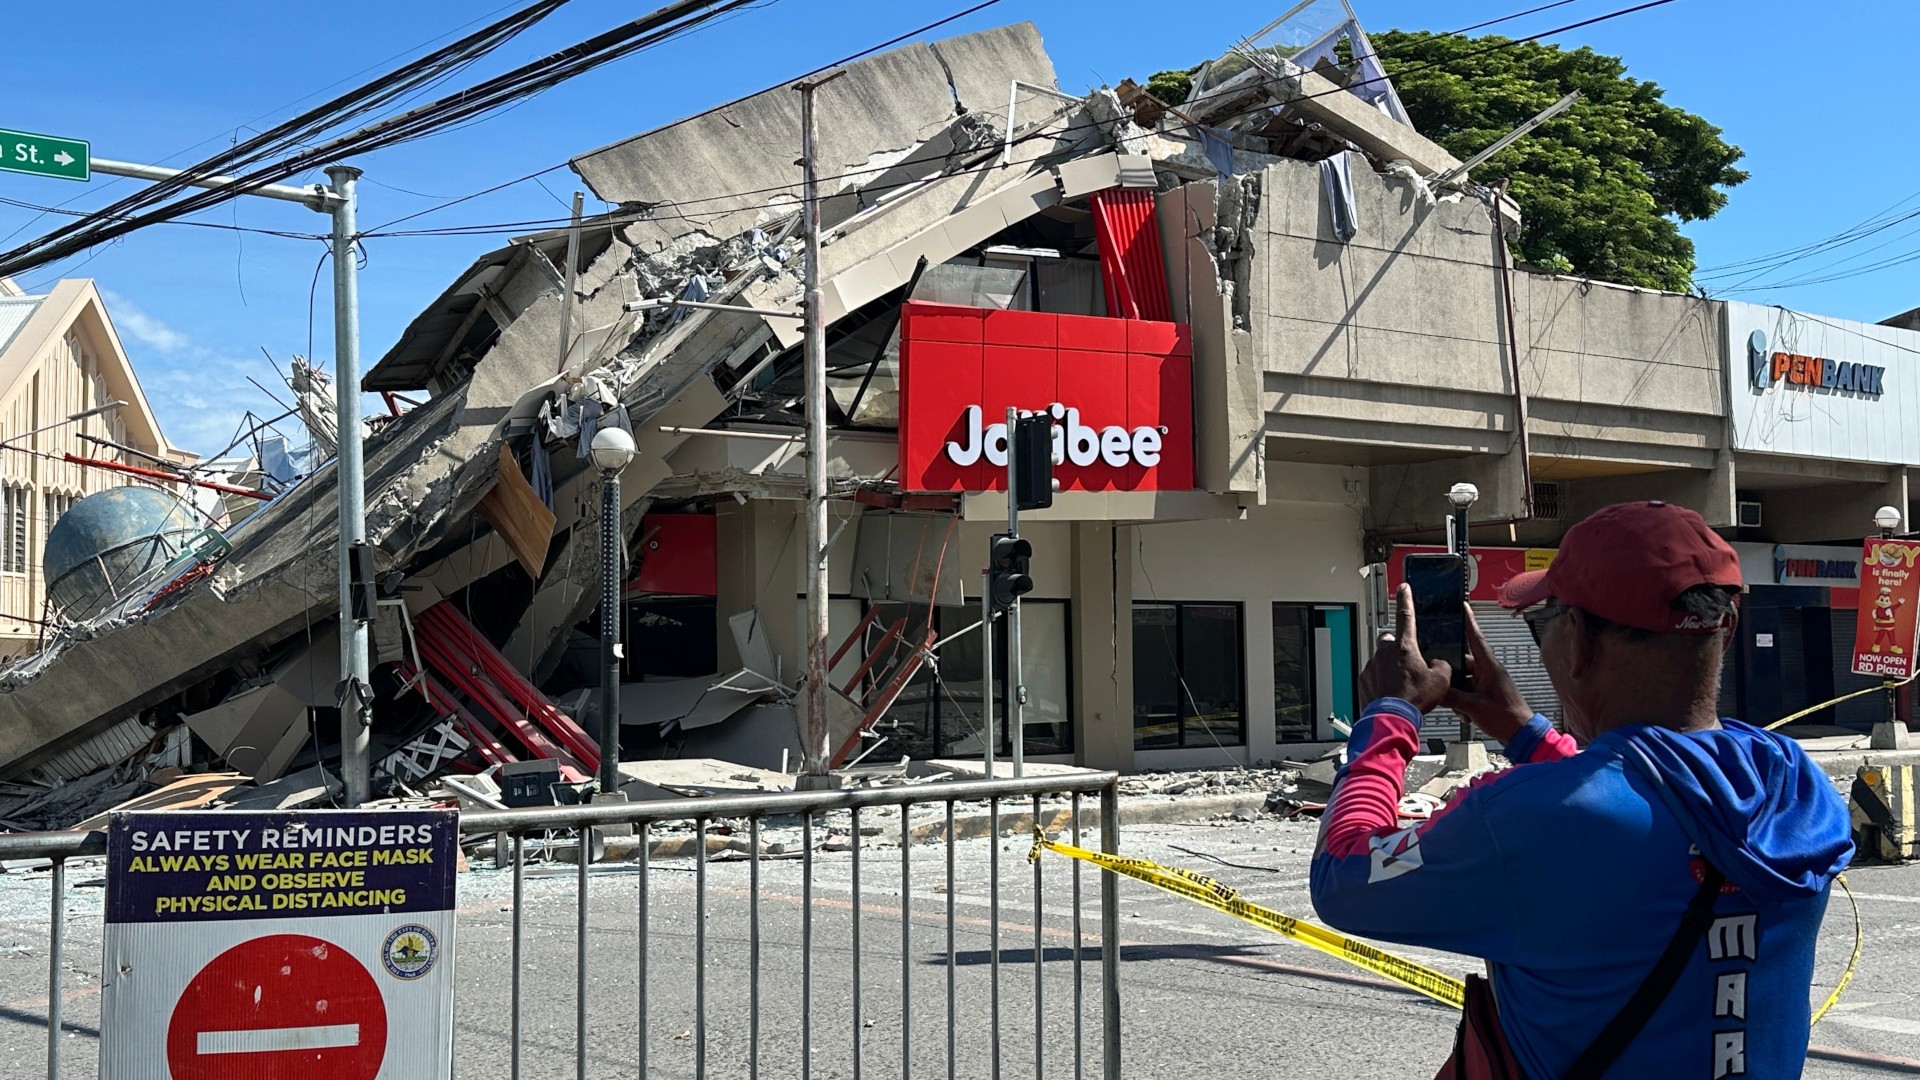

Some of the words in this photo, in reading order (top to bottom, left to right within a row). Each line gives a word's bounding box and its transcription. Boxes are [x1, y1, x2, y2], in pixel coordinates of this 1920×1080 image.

[15, 143, 44, 164] St.
[1771, 351, 1885, 394] PENBANK
[947, 403, 1162, 467] Joibee
[1786, 558, 1857, 578] PENBANK
[1872, 567, 1880, 576] is
[1882, 568, 1910, 580] finally
[1878, 577, 1902, 587] here!
[1858, 661, 1874, 672] RD
[1876, 663, 1906, 676] Plaza
[1859, 653, 1882, 663] NOW
[1883, 656, 1907, 666] OPEN
[131, 829, 251, 852] SAFETY
[262, 824, 433, 849] REMINDERS
[129, 853, 230, 873] ALWAYS
[235, 852, 304, 870] WEAR
[309, 850, 369, 869] FACE
[373, 848, 434, 866] MASK
[206, 874, 256, 892] AND
[261, 871, 365, 890] OBSERVE
[156, 893, 267, 914] PHYSICAL
[272, 889, 406, 911] DISTANCING
